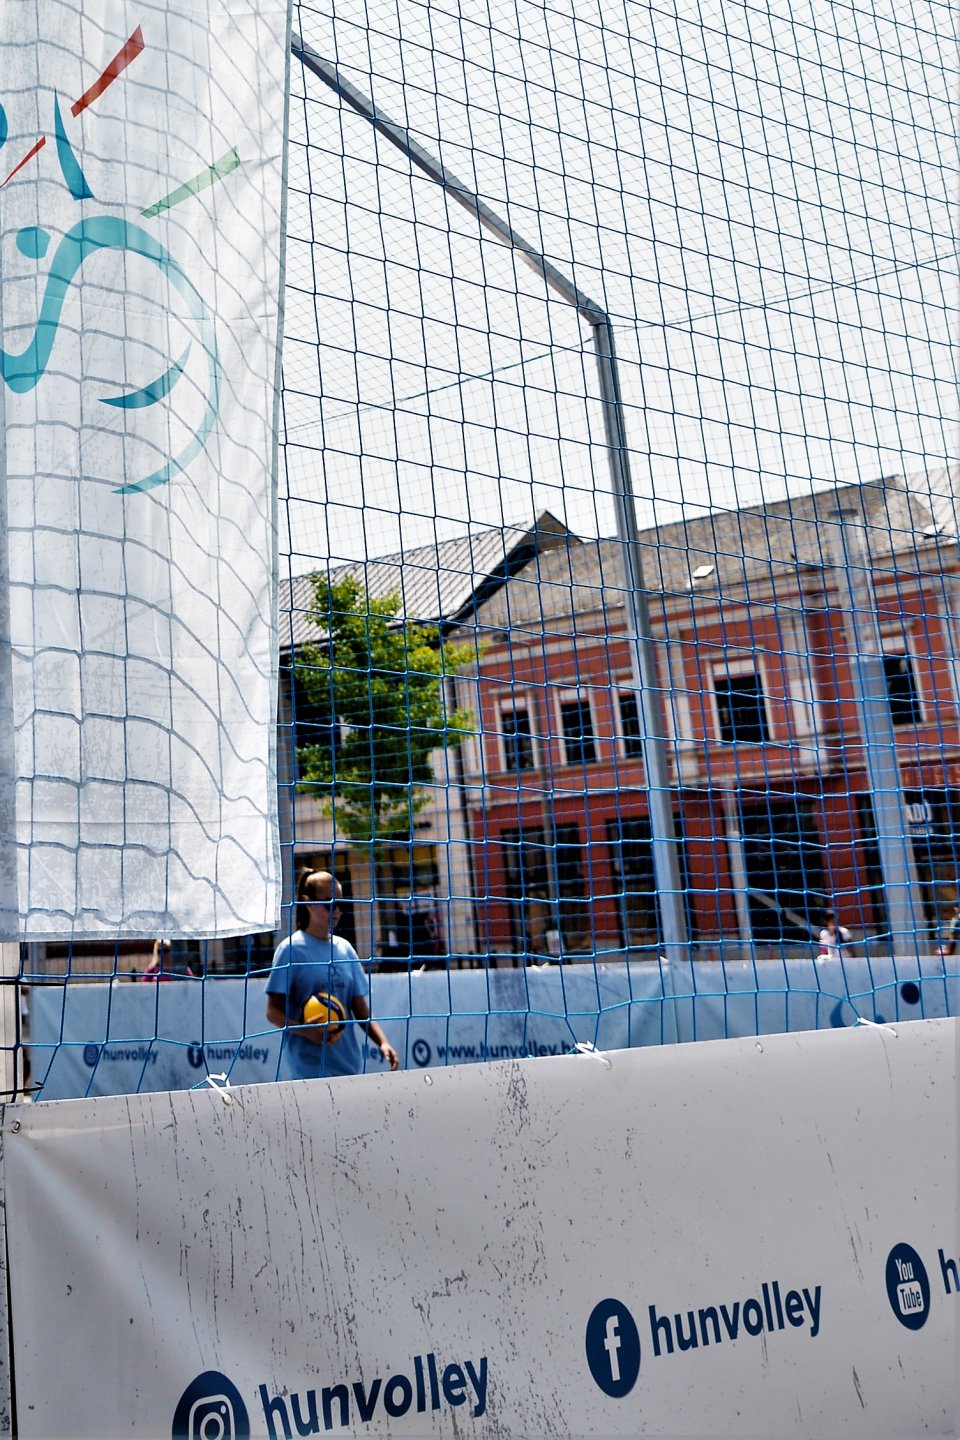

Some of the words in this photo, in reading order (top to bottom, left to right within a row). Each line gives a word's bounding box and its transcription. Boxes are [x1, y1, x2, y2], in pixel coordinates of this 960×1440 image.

[103, 1046, 159, 1063] hunvolley
[207, 1045, 269, 1063] hunvolley
[436, 1039, 585, 1058] www.hunvolley.h
[895, 1258, 914, 1281] You
[900, 1287, 922, 1310] Tube
[648, 1280, 822, 1357] hunvolley
[258, 1353, 488, 1439] hunvolley
